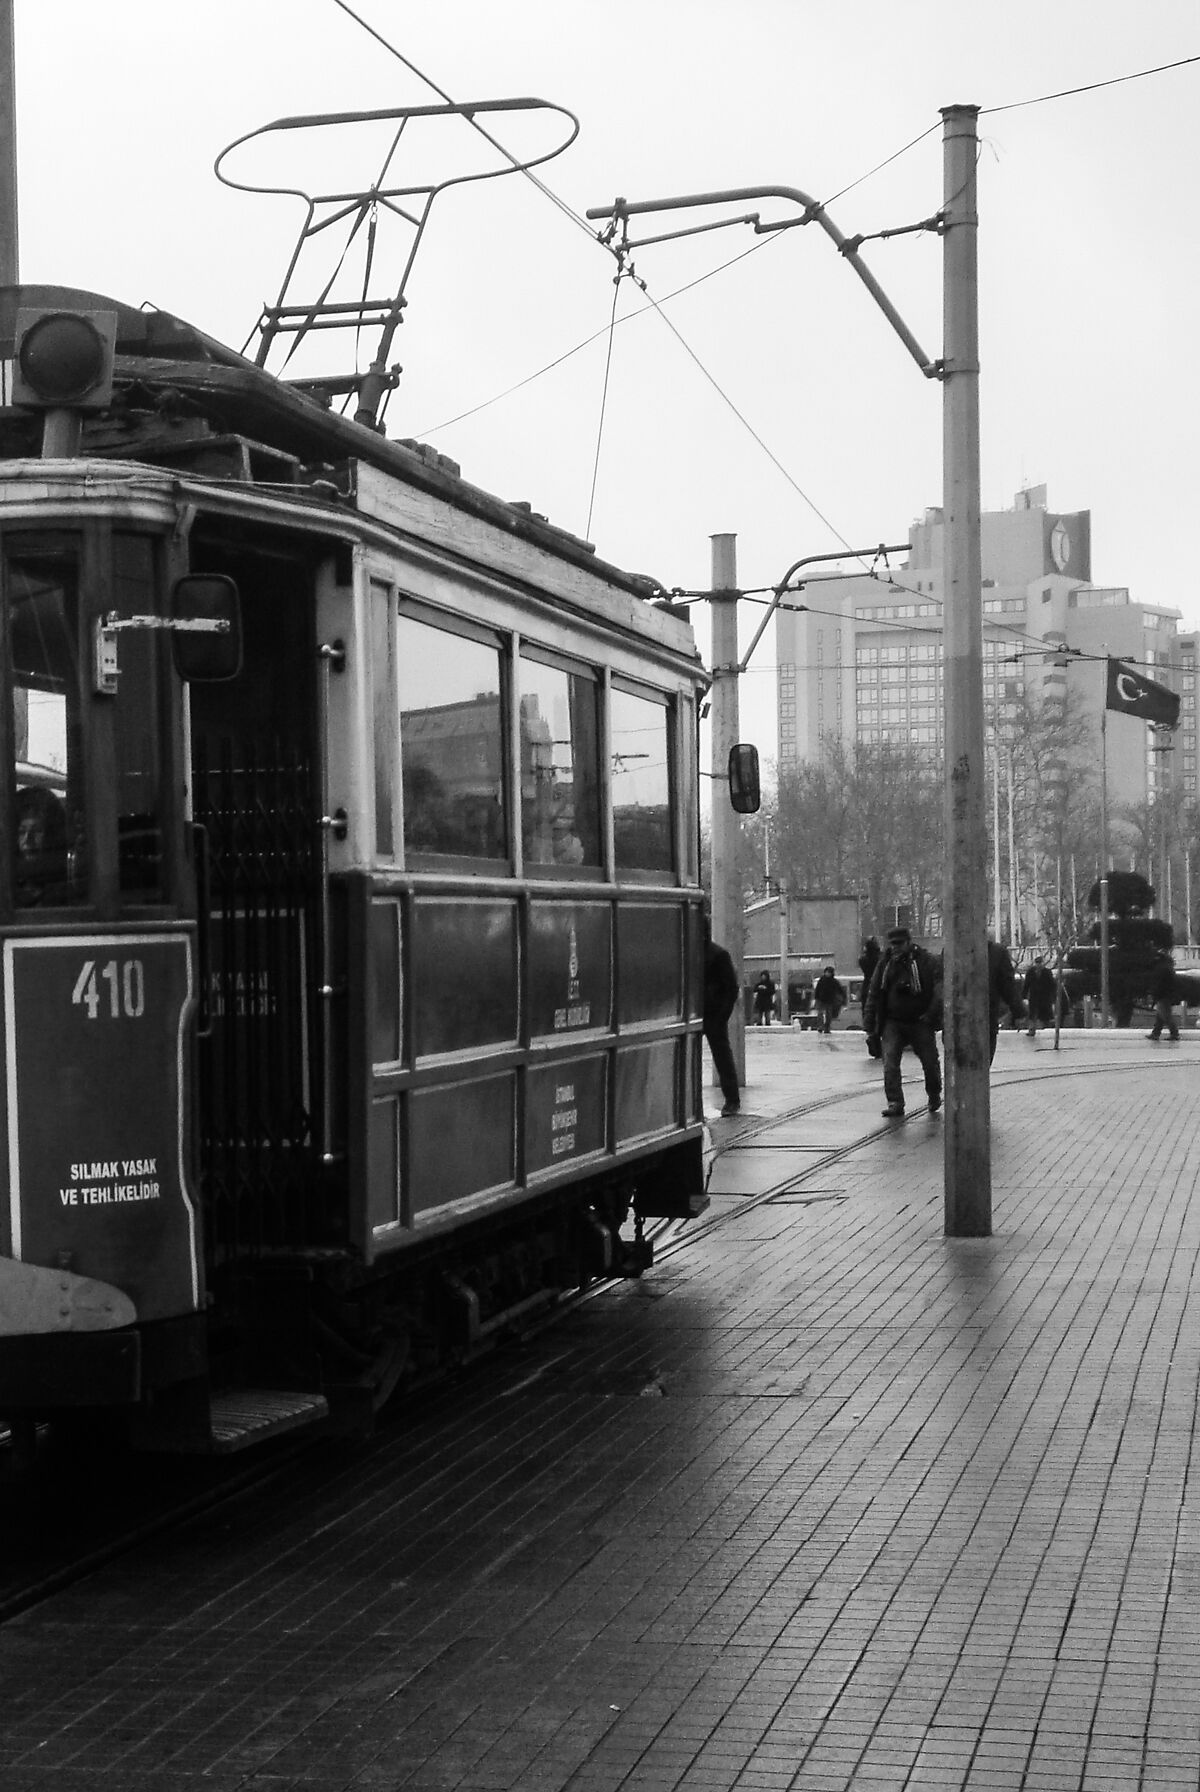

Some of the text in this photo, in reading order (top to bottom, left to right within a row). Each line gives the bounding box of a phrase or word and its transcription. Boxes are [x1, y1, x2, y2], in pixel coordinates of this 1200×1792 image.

[71, 959, 145, 1019] 410
[70, 1157, 157, 1181] SILMAK YASAK
[59, 1179, 161, 1206] VE TEHLİKELİDİR
